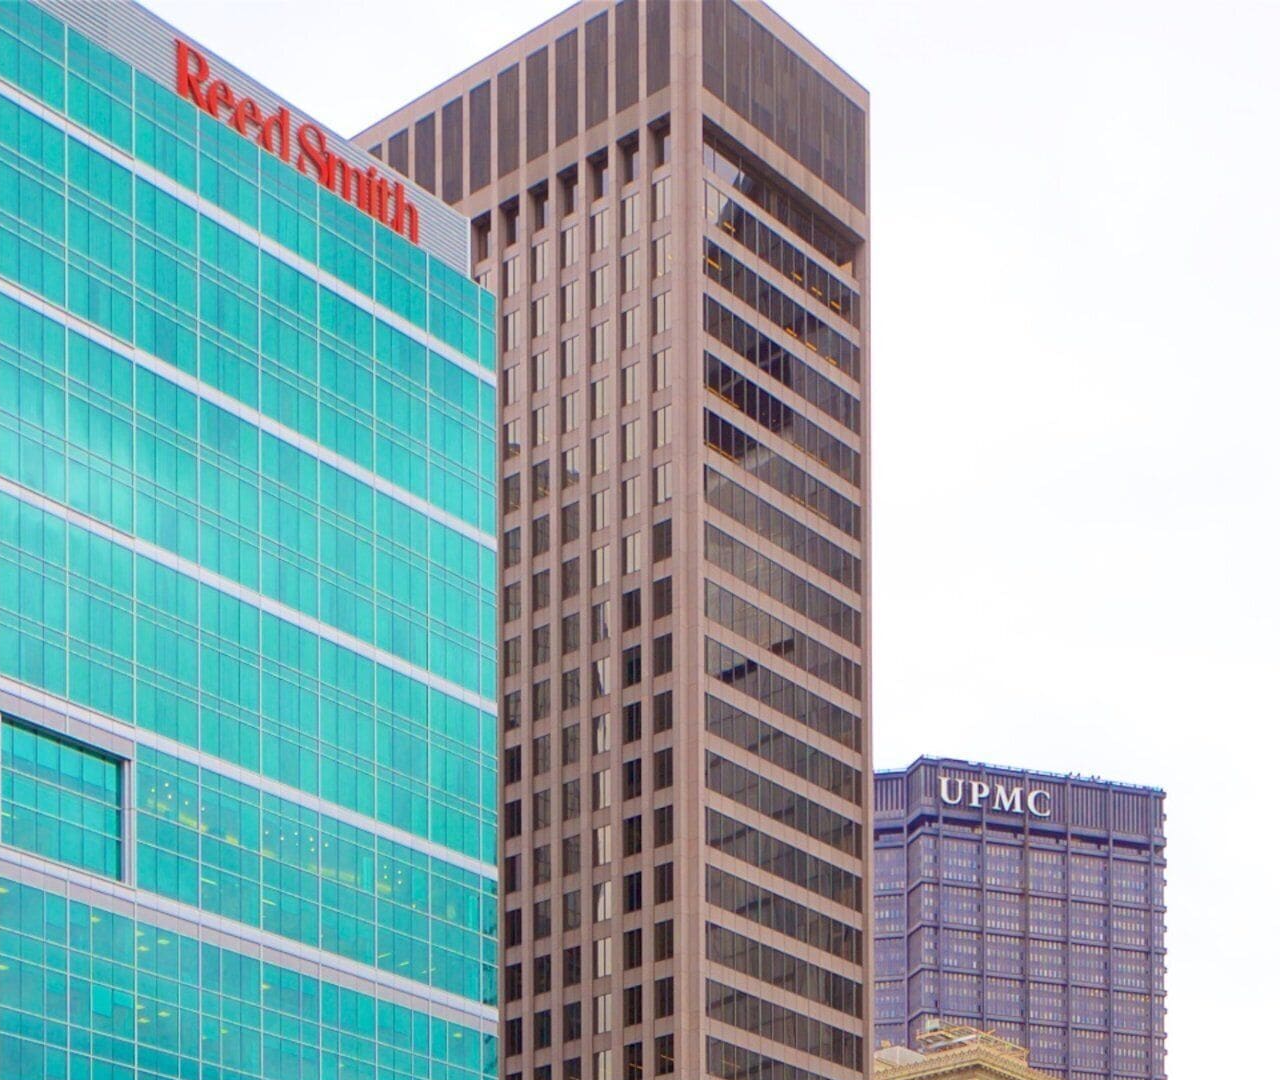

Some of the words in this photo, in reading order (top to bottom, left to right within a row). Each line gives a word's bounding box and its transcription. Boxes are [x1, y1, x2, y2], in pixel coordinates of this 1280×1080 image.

[174, 38, 291, 164] Reed
[296, 122, 419, 245] Smith
[939, 775, 1051, 817] UPMC
